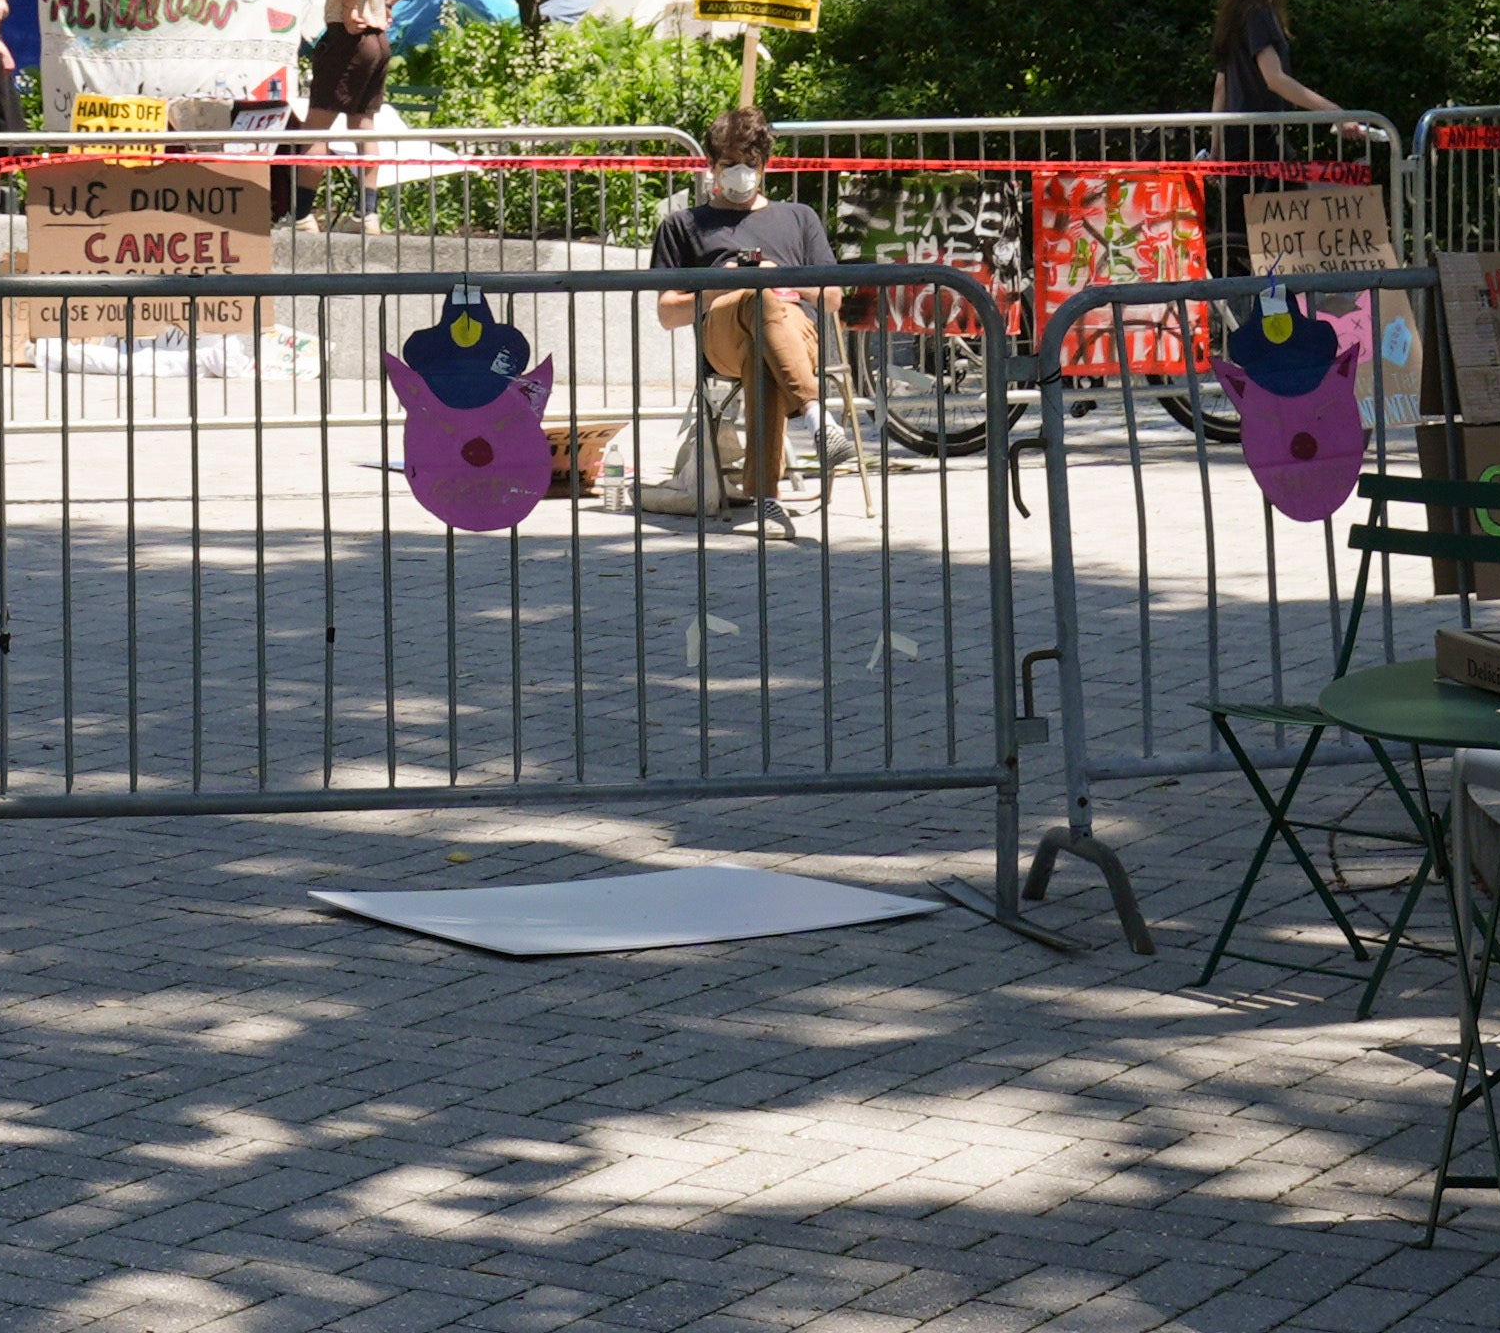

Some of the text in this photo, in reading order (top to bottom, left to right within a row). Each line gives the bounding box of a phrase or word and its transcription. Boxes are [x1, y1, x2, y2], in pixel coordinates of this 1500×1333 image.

[76, 102, 163, 122] HANDS OFF
[43, 181, 244, 219] WE DID NOT
[1263, 195, 1364, 225] MAY THY
[84, 231, 241, 265] CANCEL
[1261, 229, 1380, 260] RIOT GEAR
[96, 302, 136, 322] YOU
